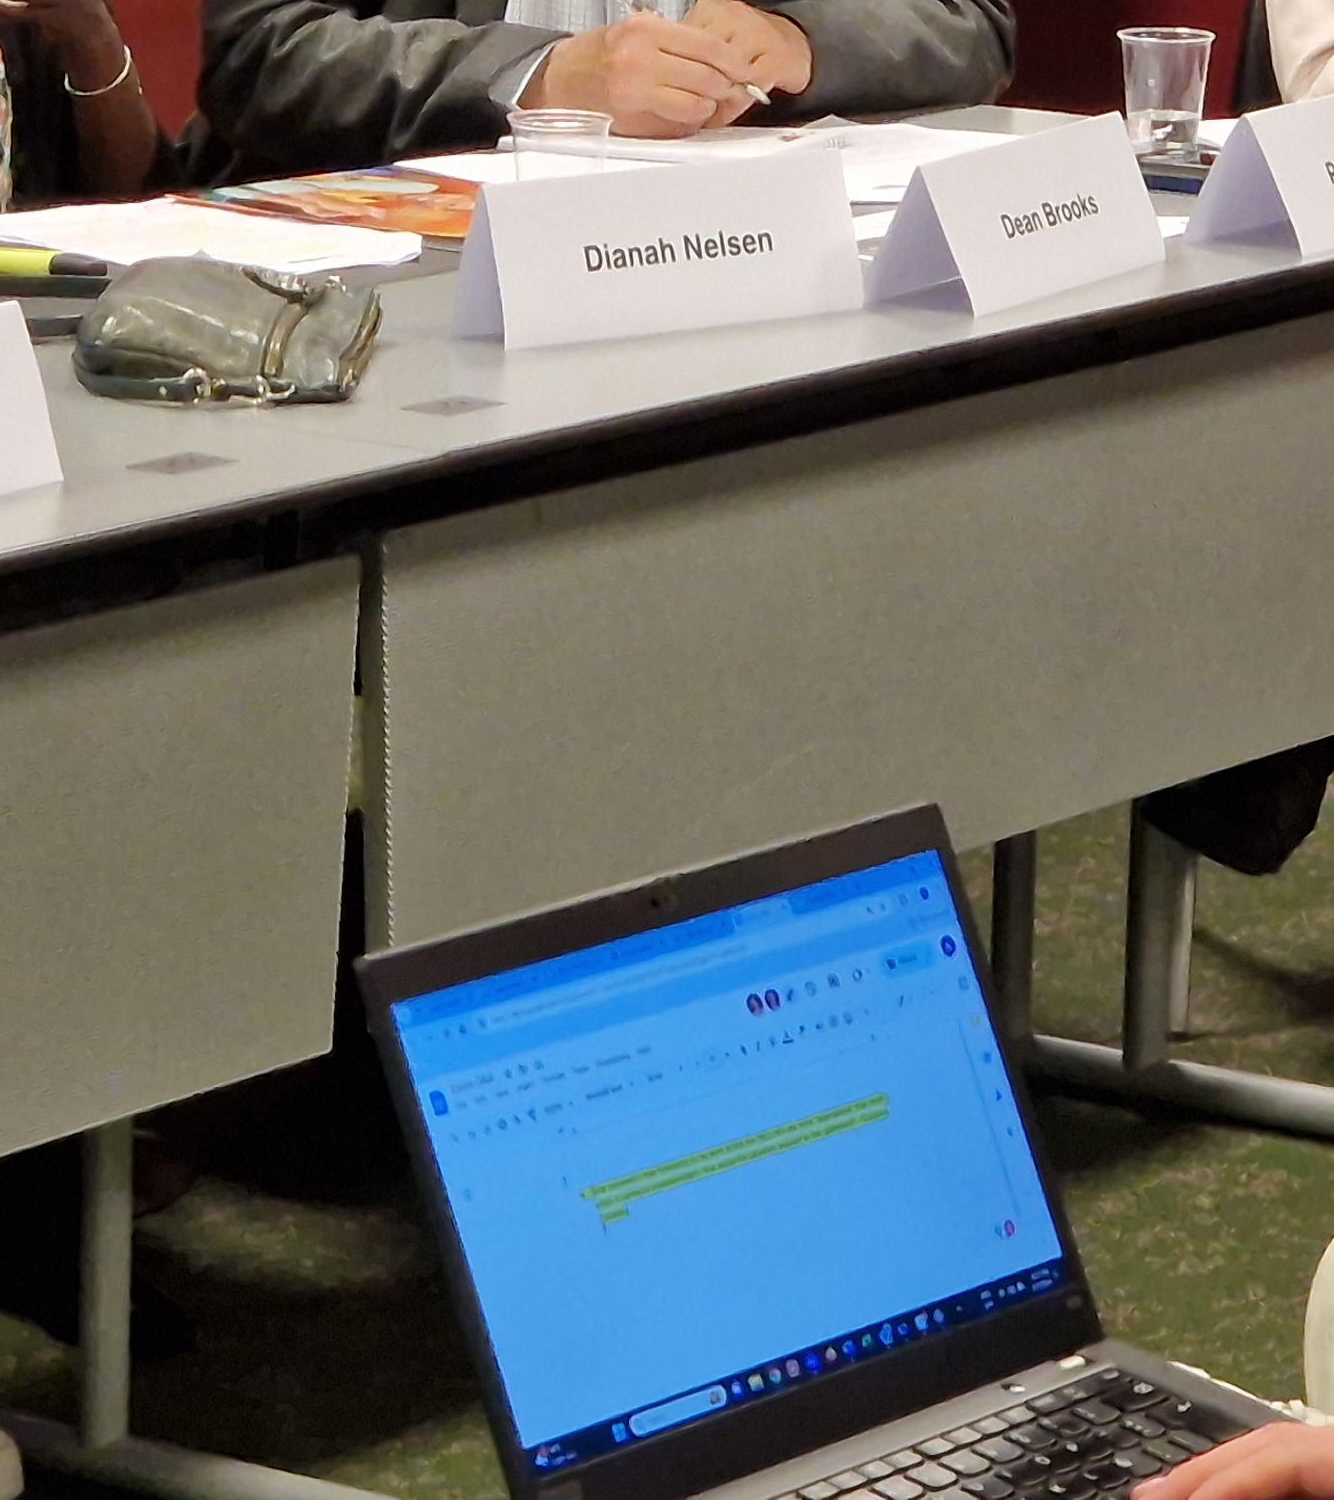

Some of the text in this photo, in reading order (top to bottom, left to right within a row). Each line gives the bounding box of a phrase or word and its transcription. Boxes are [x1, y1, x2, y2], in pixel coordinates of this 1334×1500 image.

[1000, 193, 1099, 239] Dean Brooks
[583, 230, 774, 272] Dianah Nelsen
